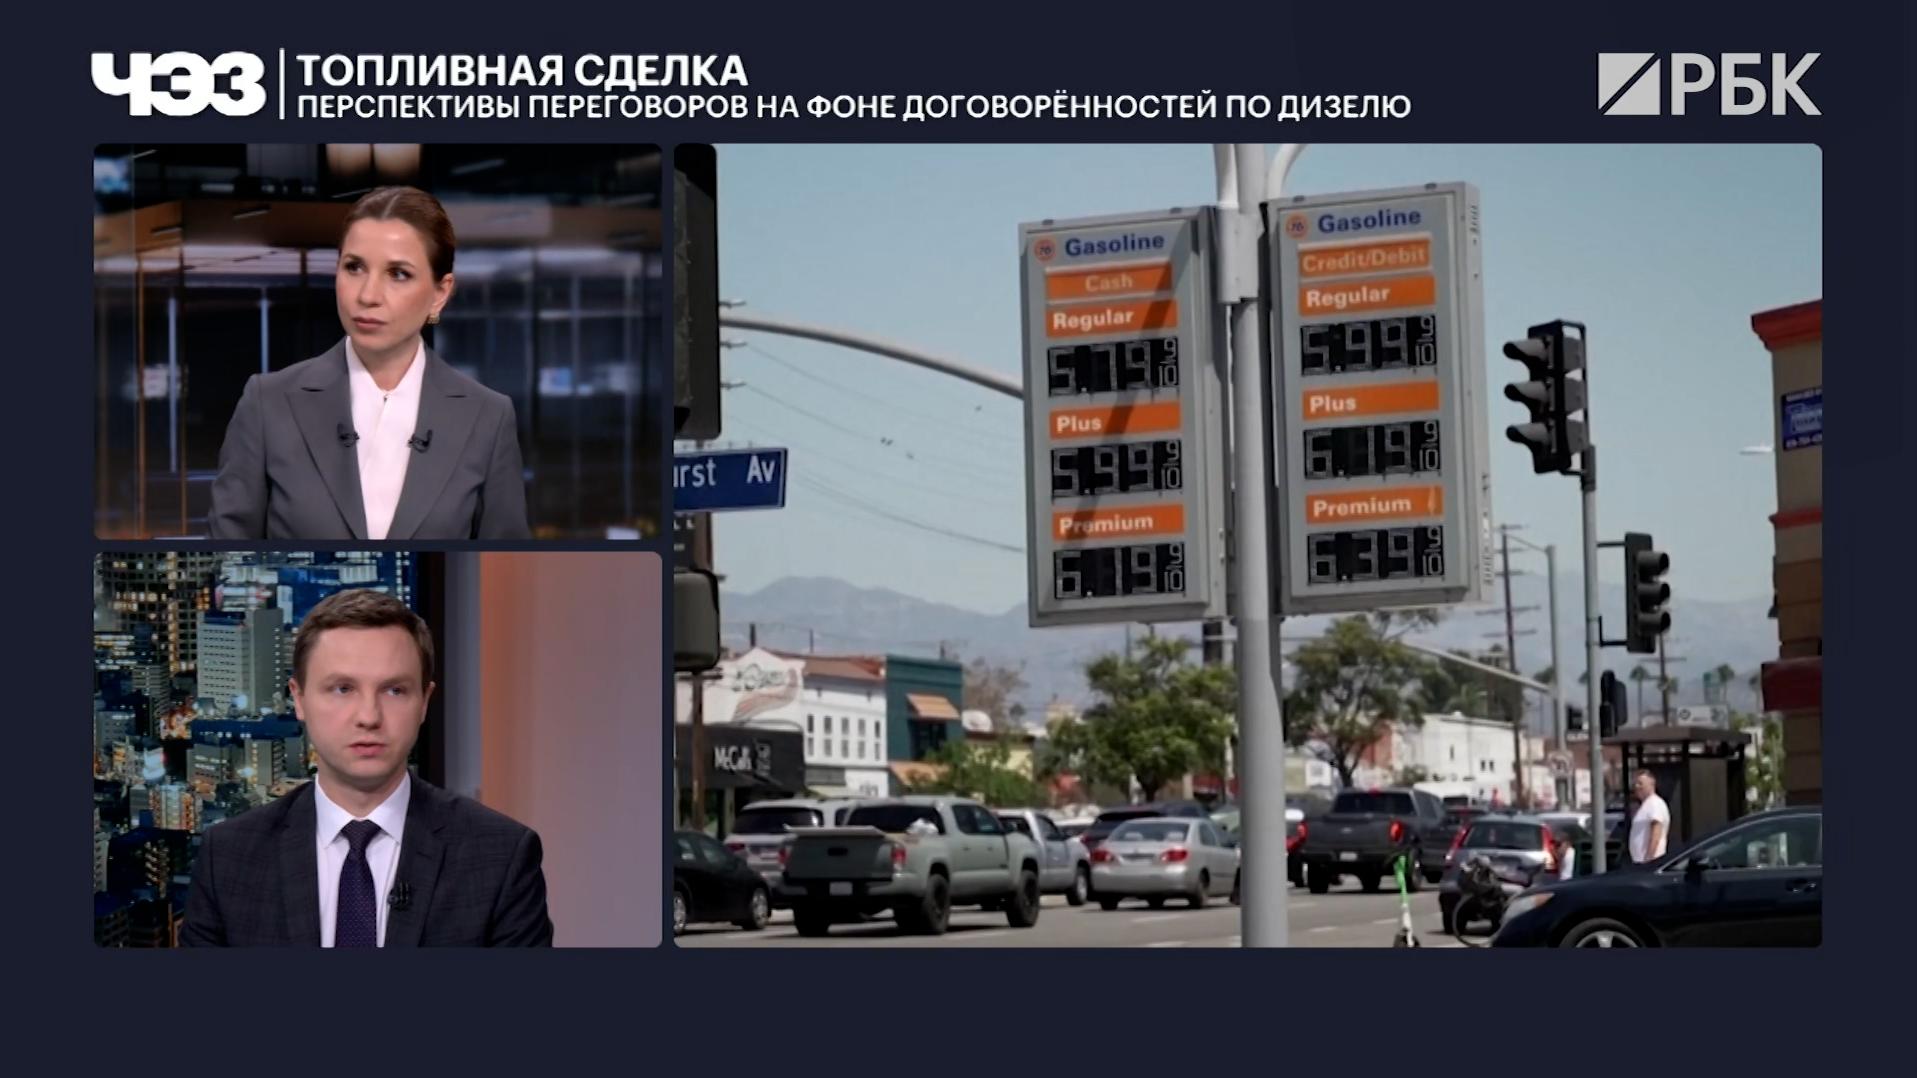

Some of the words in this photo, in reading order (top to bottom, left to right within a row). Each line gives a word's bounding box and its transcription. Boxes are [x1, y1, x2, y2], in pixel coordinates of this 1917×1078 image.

[1318, 208, 1422, 234] Gasoline
[1065, 233, 1165, 257] Gasoline
[1302, 246, 1426, 272] Credit/Debit
[1085, 274, 1133, 292] Cash
[1306, 286, 1390, 309] Regular
[1053, 309, 1134, 331] Regular
[1309, 396, 1357, 414] Plus
[1056, 415, 1102, 433] Plus
[746, 455, 776, 484] Av
[1313, 496, 1412, 518] Premium
[1059, 513, 1154, 535] Premium
